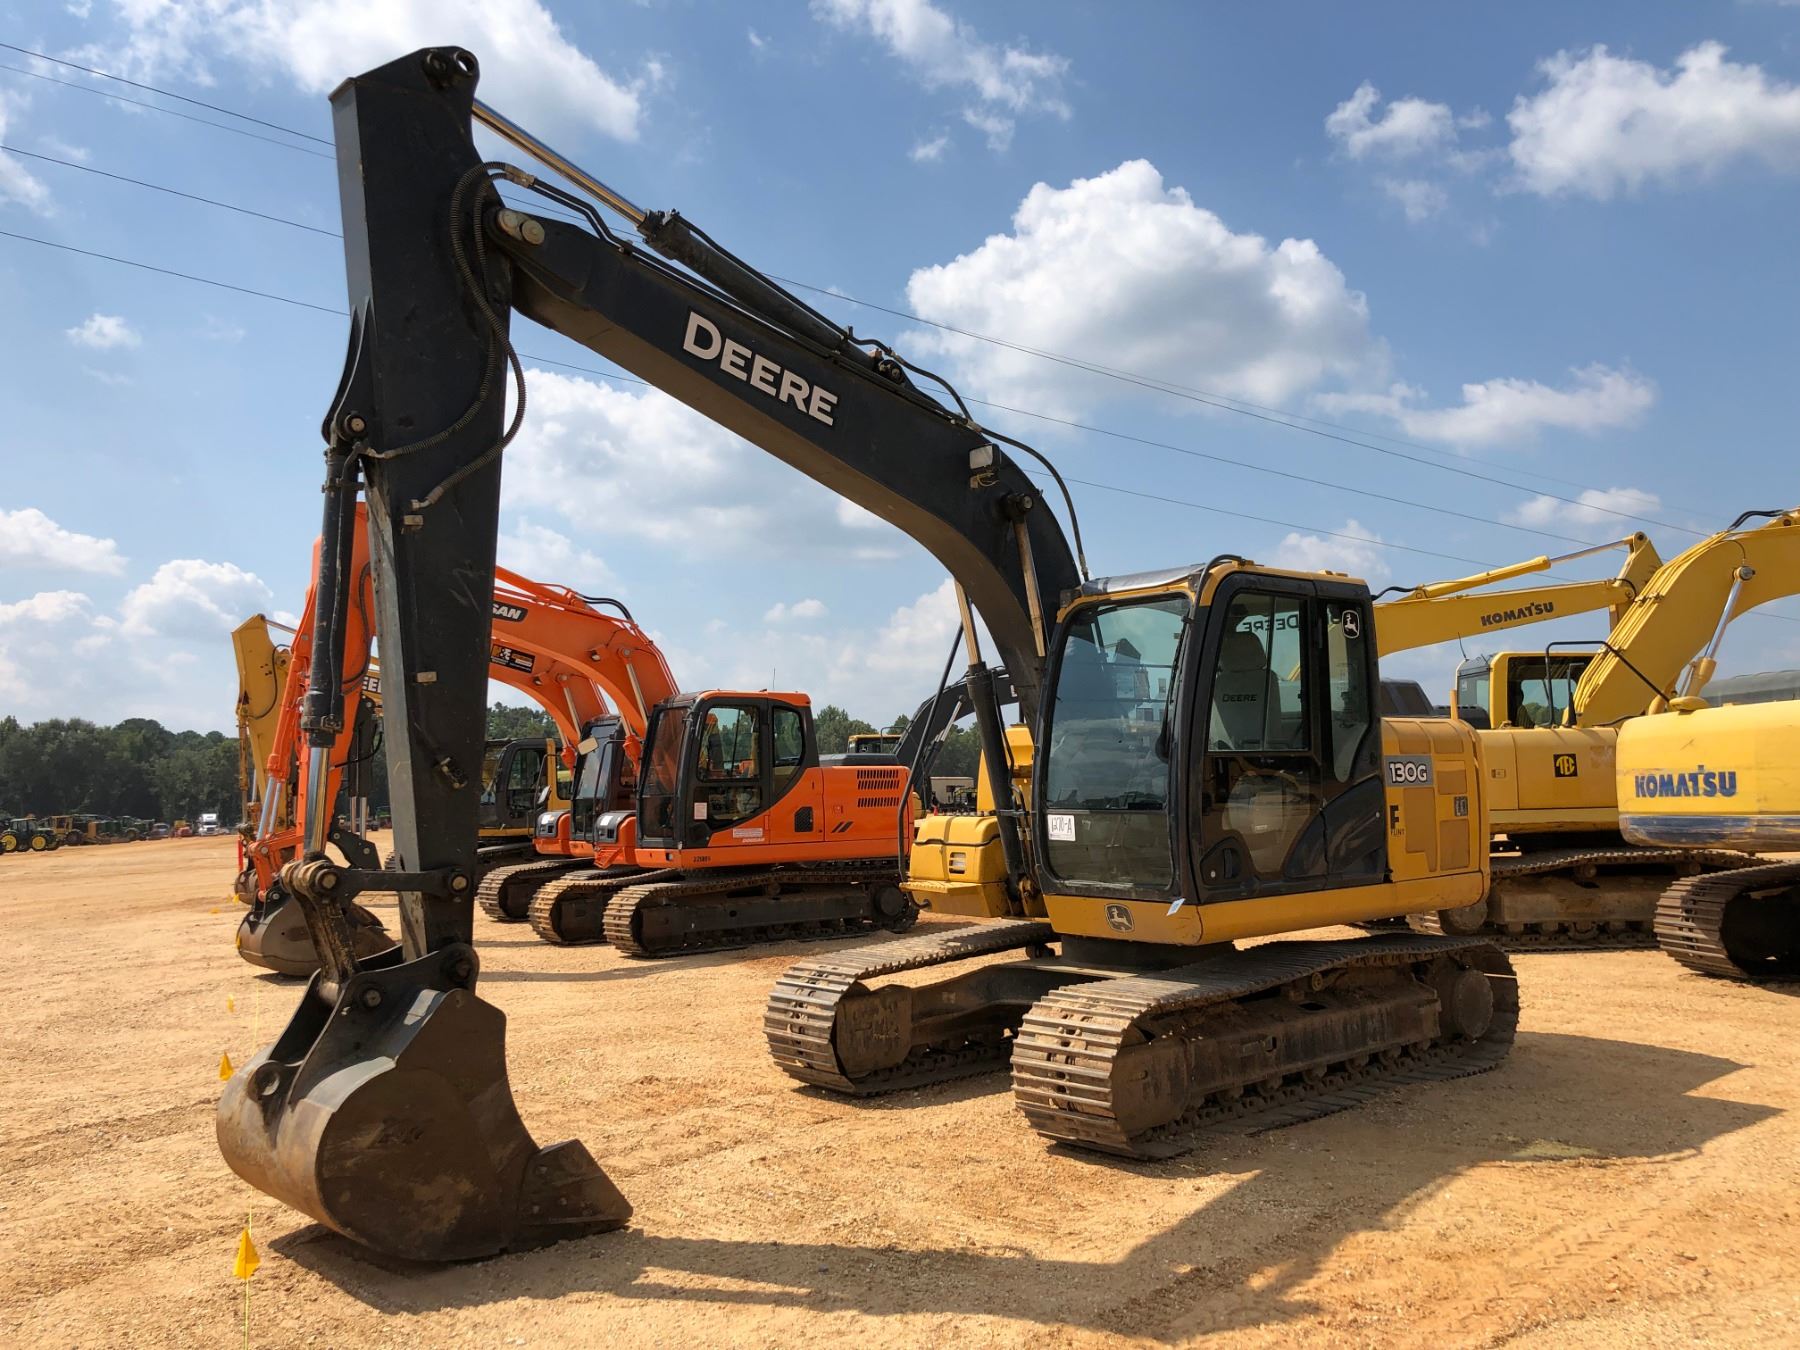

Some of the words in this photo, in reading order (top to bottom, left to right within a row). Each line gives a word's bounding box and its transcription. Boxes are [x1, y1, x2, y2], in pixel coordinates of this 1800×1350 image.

[683, 311, 838, 426] DEERE
[1480, 602, 1554, 626] KOMATSU
[1222, 694, 1257, 702] DEERE
[1389, 761, 1427, 783] 130G
[1635, 765, 1737, 797] KOMATSU
